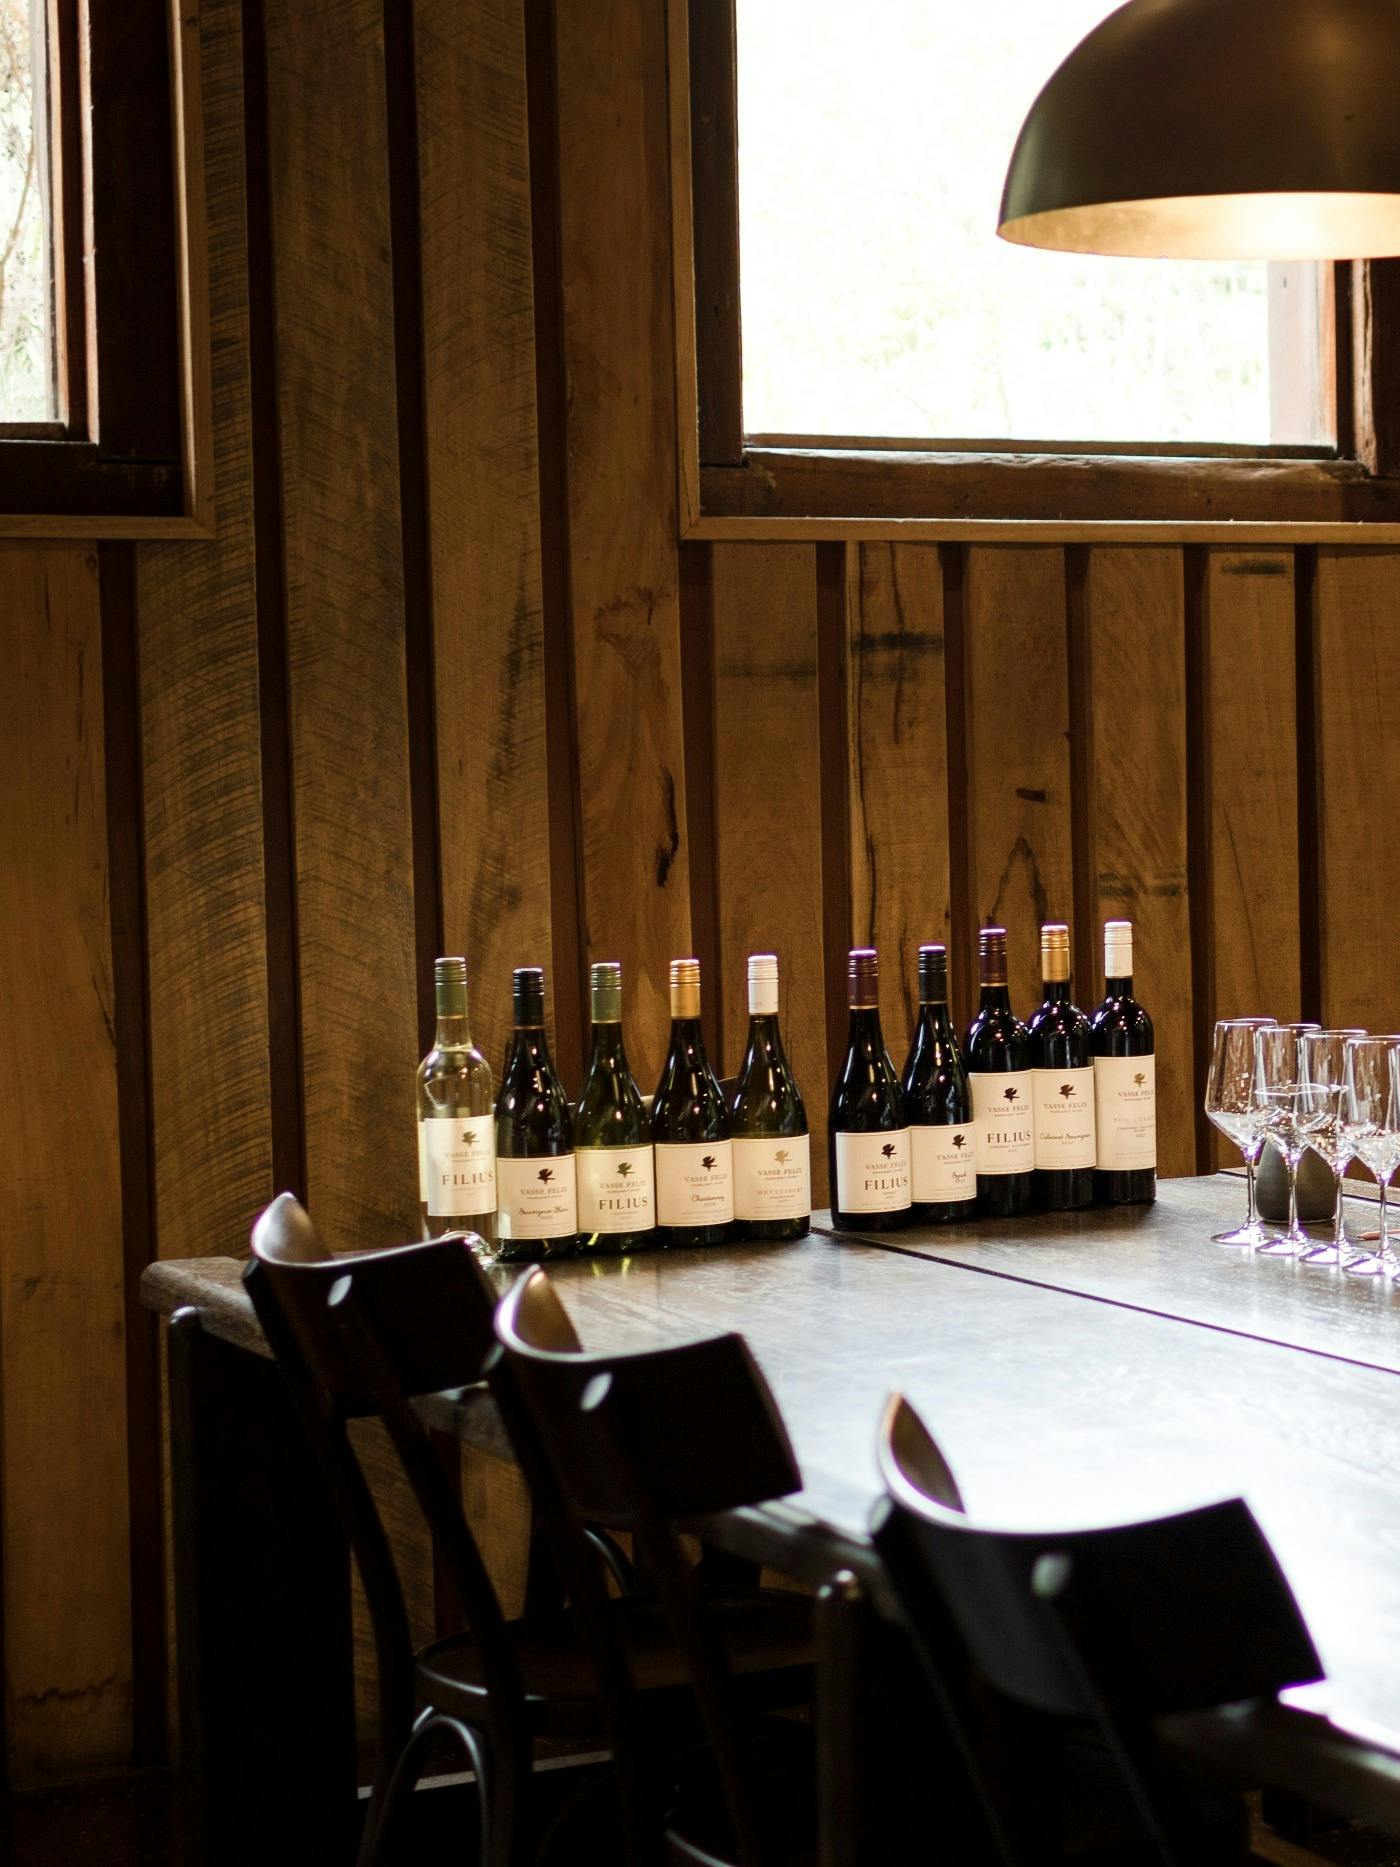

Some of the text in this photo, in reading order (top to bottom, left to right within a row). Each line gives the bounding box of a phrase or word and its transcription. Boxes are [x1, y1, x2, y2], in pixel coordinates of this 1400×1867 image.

[987, 1130, 1032, 1143] FILIUS
[442, 1170, 494, 1185] FILIUS
[864, 1176, 909, 1191] FILIUS
[599, 1196, 648, 1210] FILIUS
